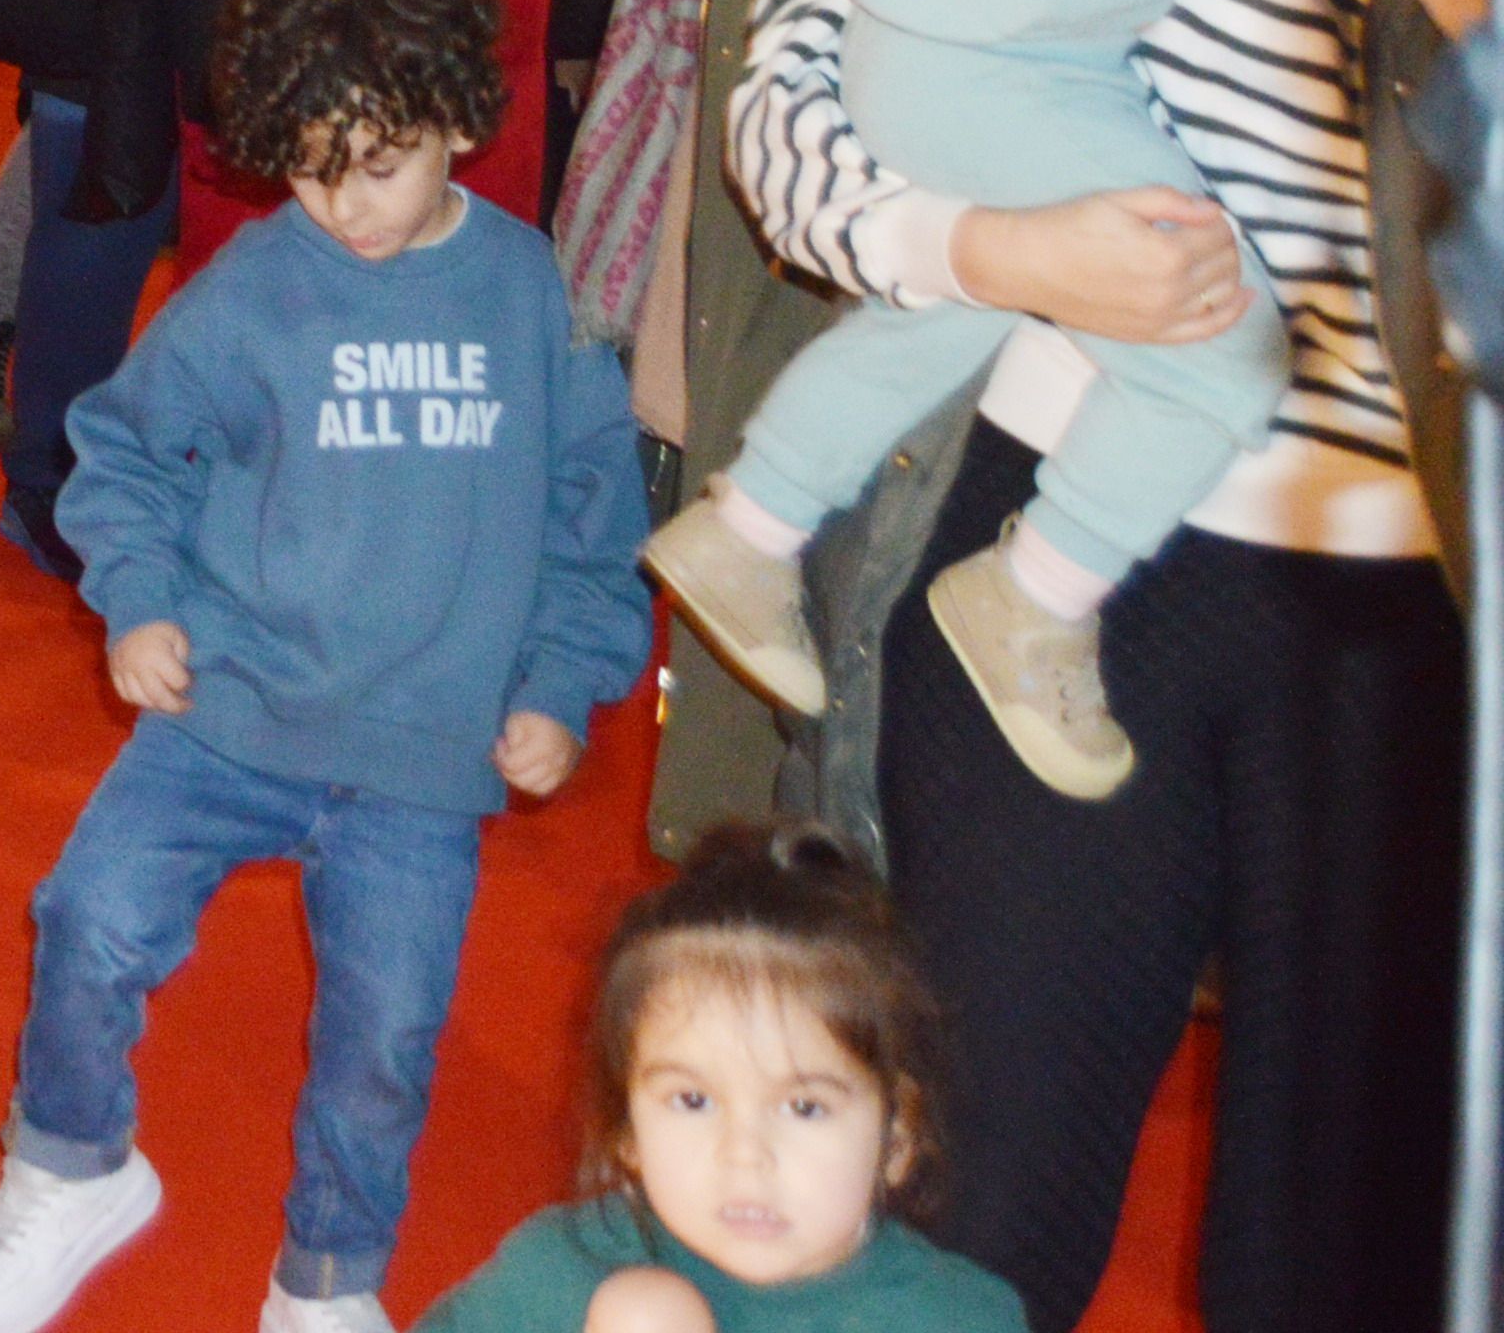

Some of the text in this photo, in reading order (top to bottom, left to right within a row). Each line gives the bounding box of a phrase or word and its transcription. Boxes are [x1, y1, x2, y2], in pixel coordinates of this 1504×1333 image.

[333, 341, 487, 392] SMILE
[317, 396, 503, 448] ALL DAY
